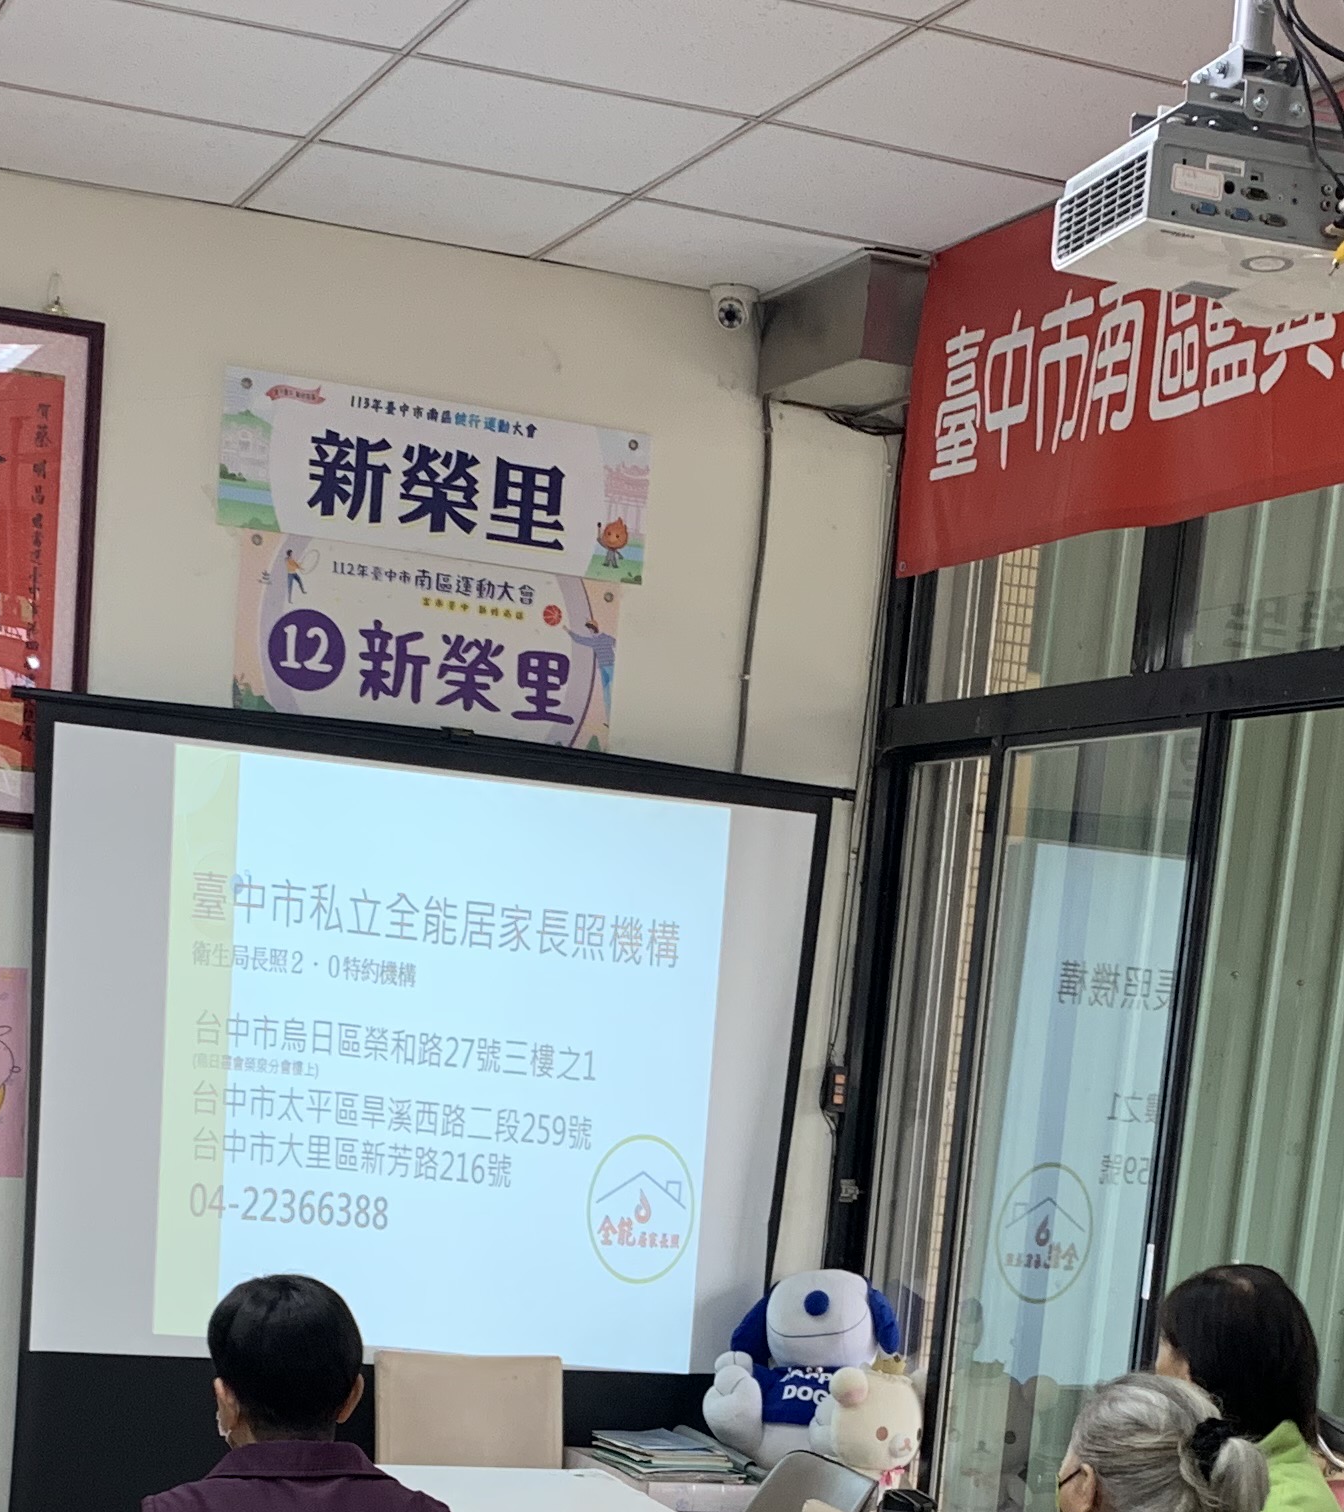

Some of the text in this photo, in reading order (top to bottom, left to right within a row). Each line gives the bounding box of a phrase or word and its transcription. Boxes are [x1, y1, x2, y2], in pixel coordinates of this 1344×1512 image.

[350, 395, 538, 439] 113年臺中市南區健行運動大會
[307, 428, 567, 552] 新榮里
[332, 561, 536, 606] 112年臺中市南區運動大會
[278, 623, 334, 673] 12
[358, 618, 575, 726] 新榮里
[191, 870, 681, 969] 臺中市私立全能居家長照機構
[194, 1008, 598, 1082] 台中市烏日區榮和路27號三樓之1
[192, 1079, 593, 1151] 台中市太平區旱溪西路二段259號
[192, 1126, 513, 1189] 台中市大里區新芳路216號
[190, 1183, 390, 1231] 04-22366388
